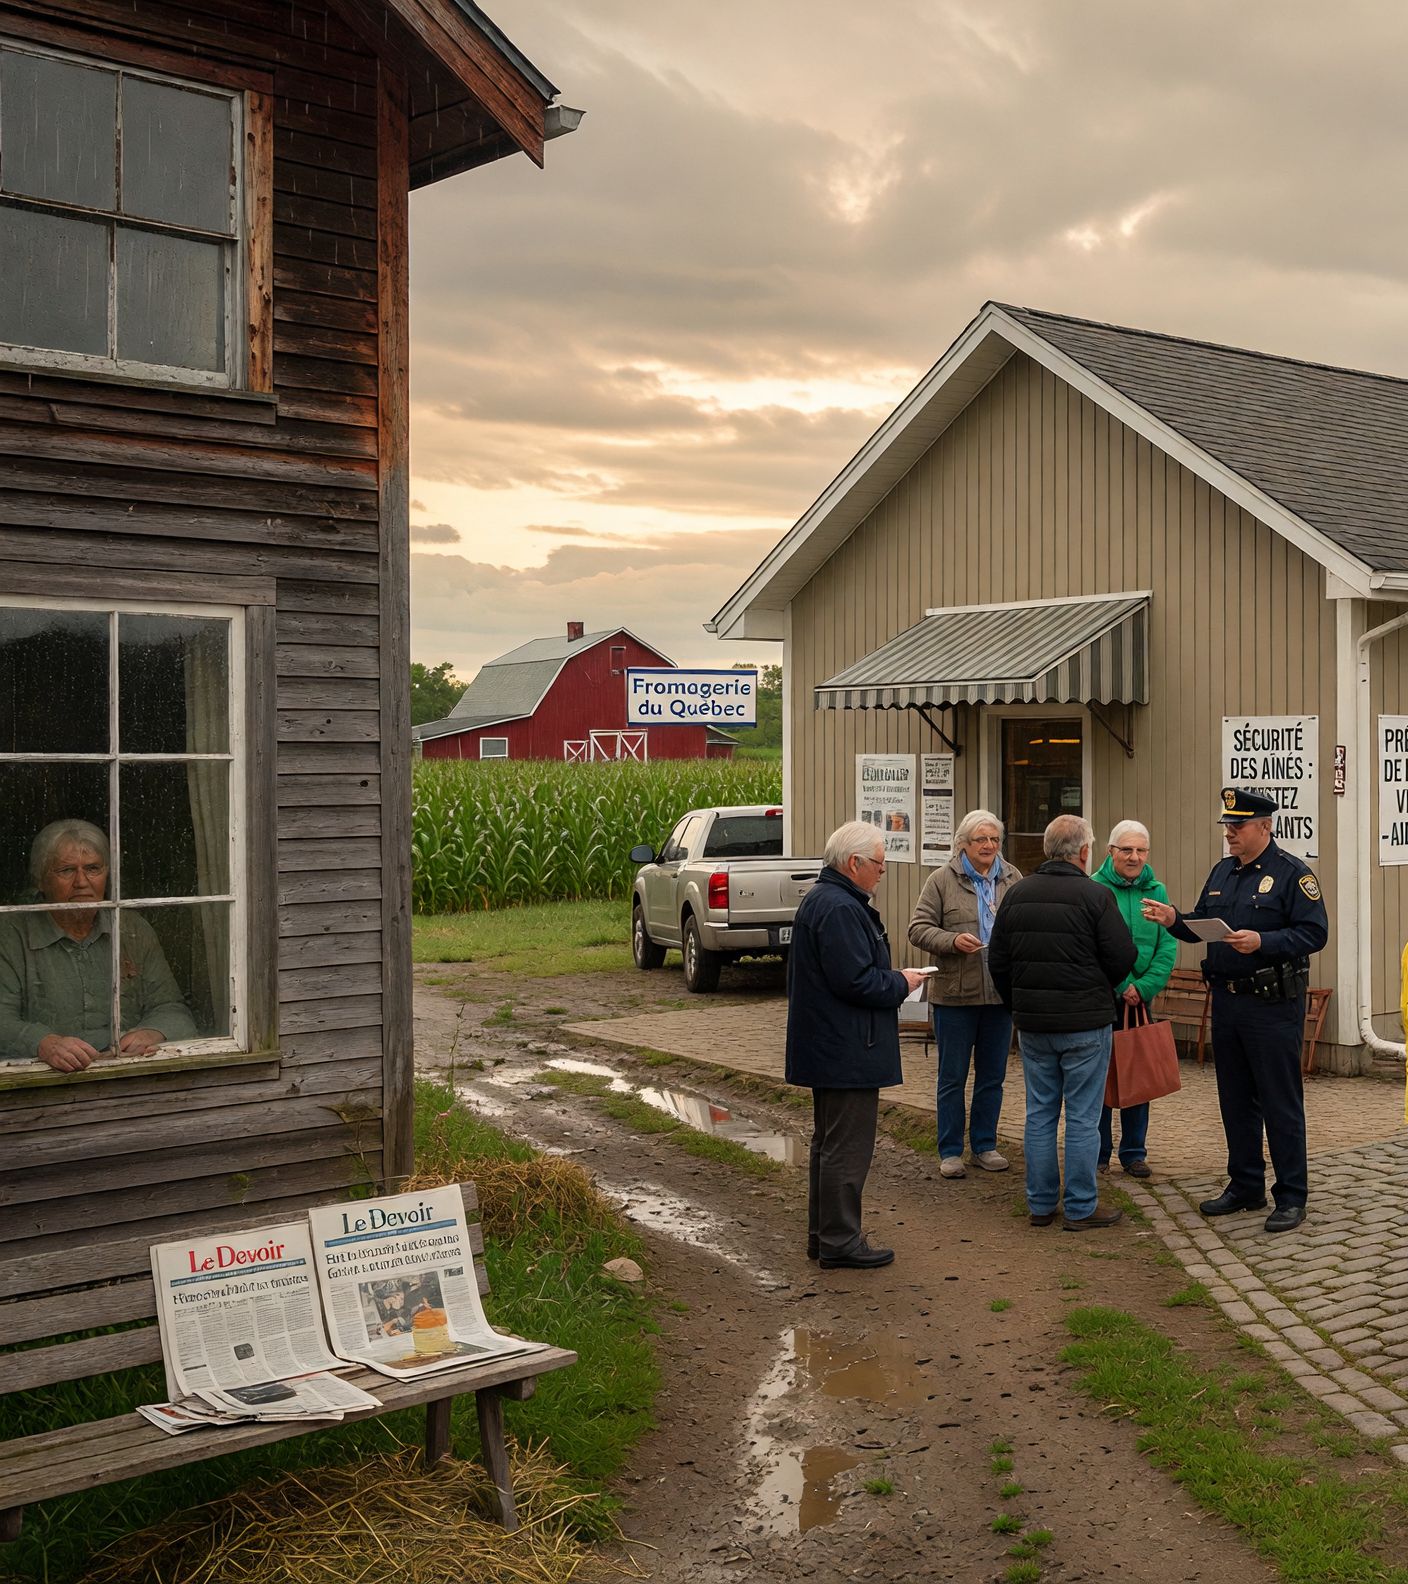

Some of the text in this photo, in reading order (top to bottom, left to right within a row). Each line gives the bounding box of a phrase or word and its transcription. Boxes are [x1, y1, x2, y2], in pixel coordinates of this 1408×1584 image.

[632, 677, 752, 699] Fromagerie
[637, 699, 746, 719] du Québec
[1233, 721, 1304, 752] SÉCURITÉ
[1230, 757, 1258, 780] DES
[1384, 758, 1402, 782] DE
[341, 1212, 368, 1235] Le
[368, 1201, 435, 1231] Devoir
[188, 1248, 215, 1274] Le
[216, 1239, 285, 1269] Devoir
